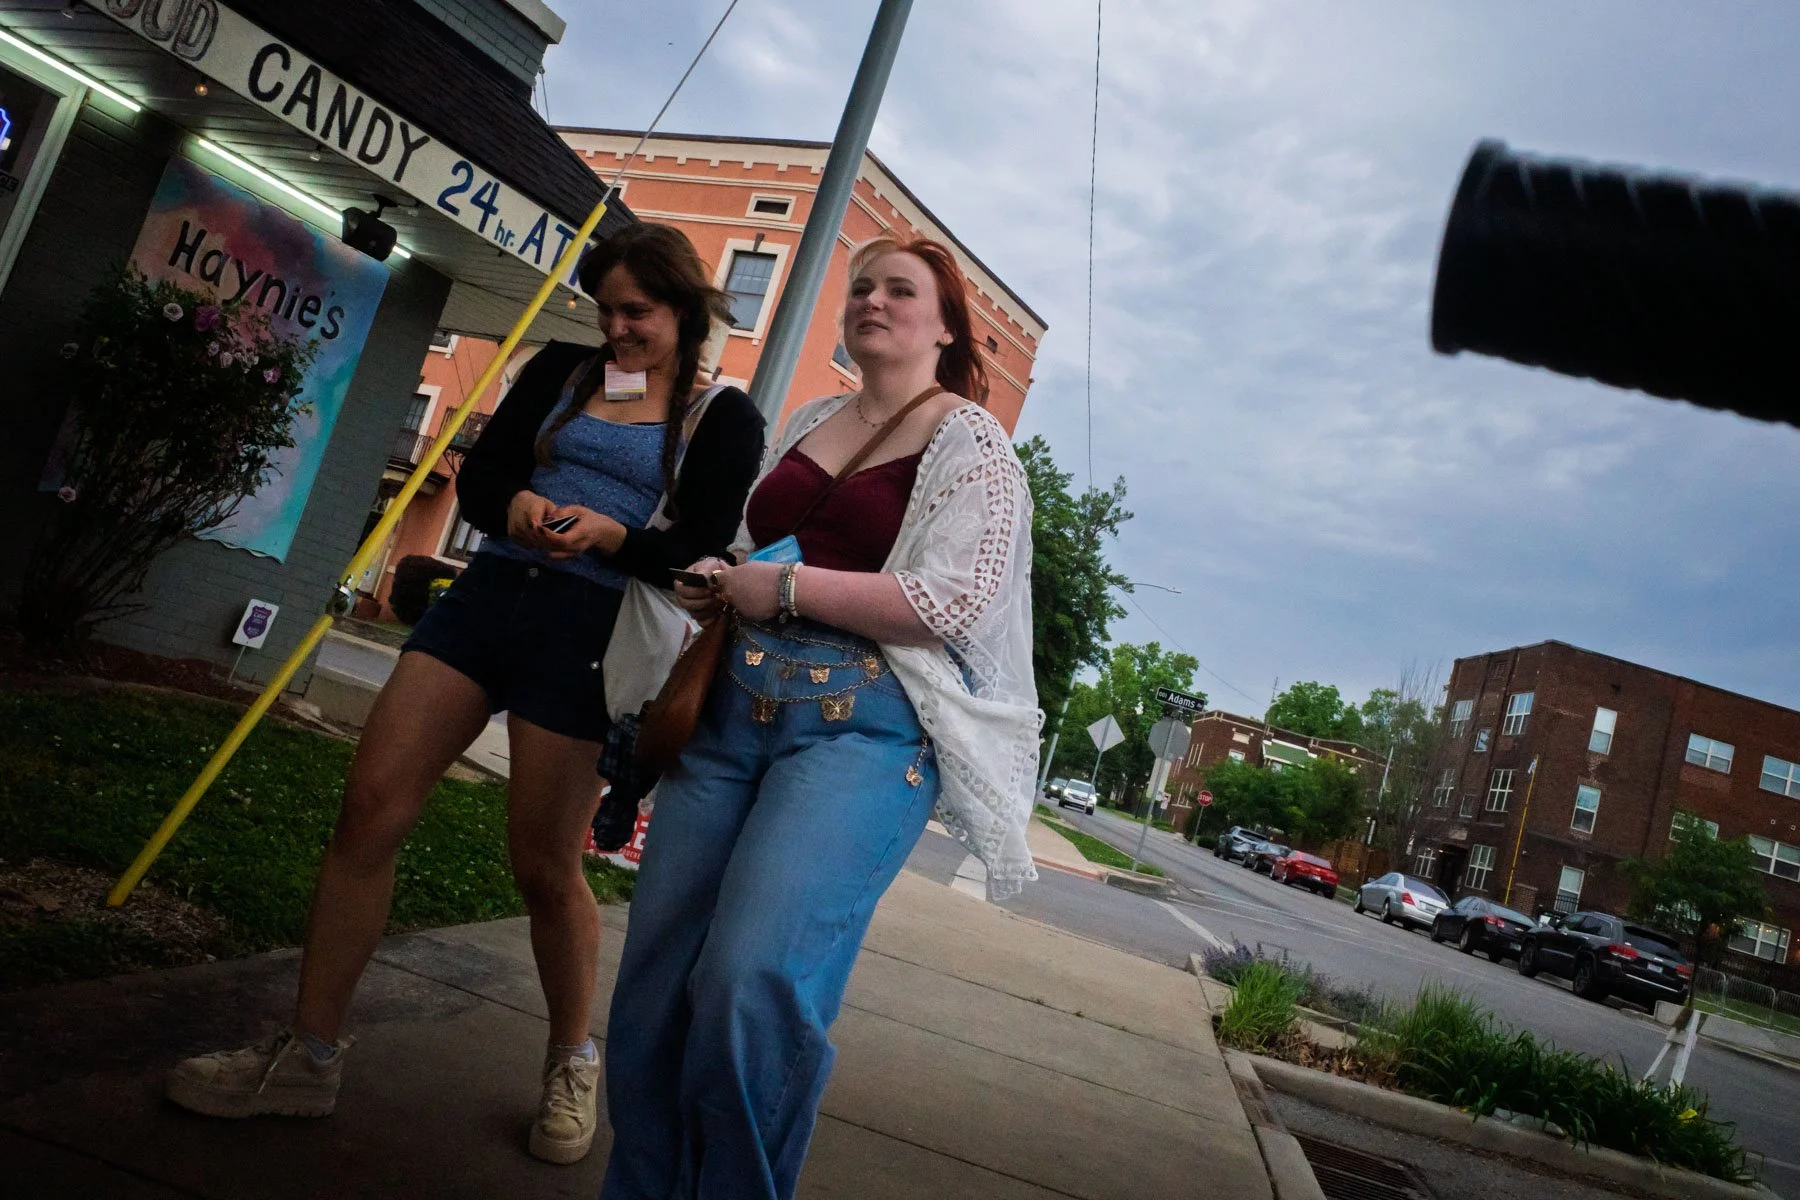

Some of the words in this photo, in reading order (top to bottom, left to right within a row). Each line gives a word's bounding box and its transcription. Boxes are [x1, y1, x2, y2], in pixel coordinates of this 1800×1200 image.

[247, 43, 431, 183] CANDY
[517, 211, 592, 287] AT
[168, 220, 345, 340] Haynie's
[1168, 692, 1196, 709] Adams
[1199, 794, 1211, 803] STOP
